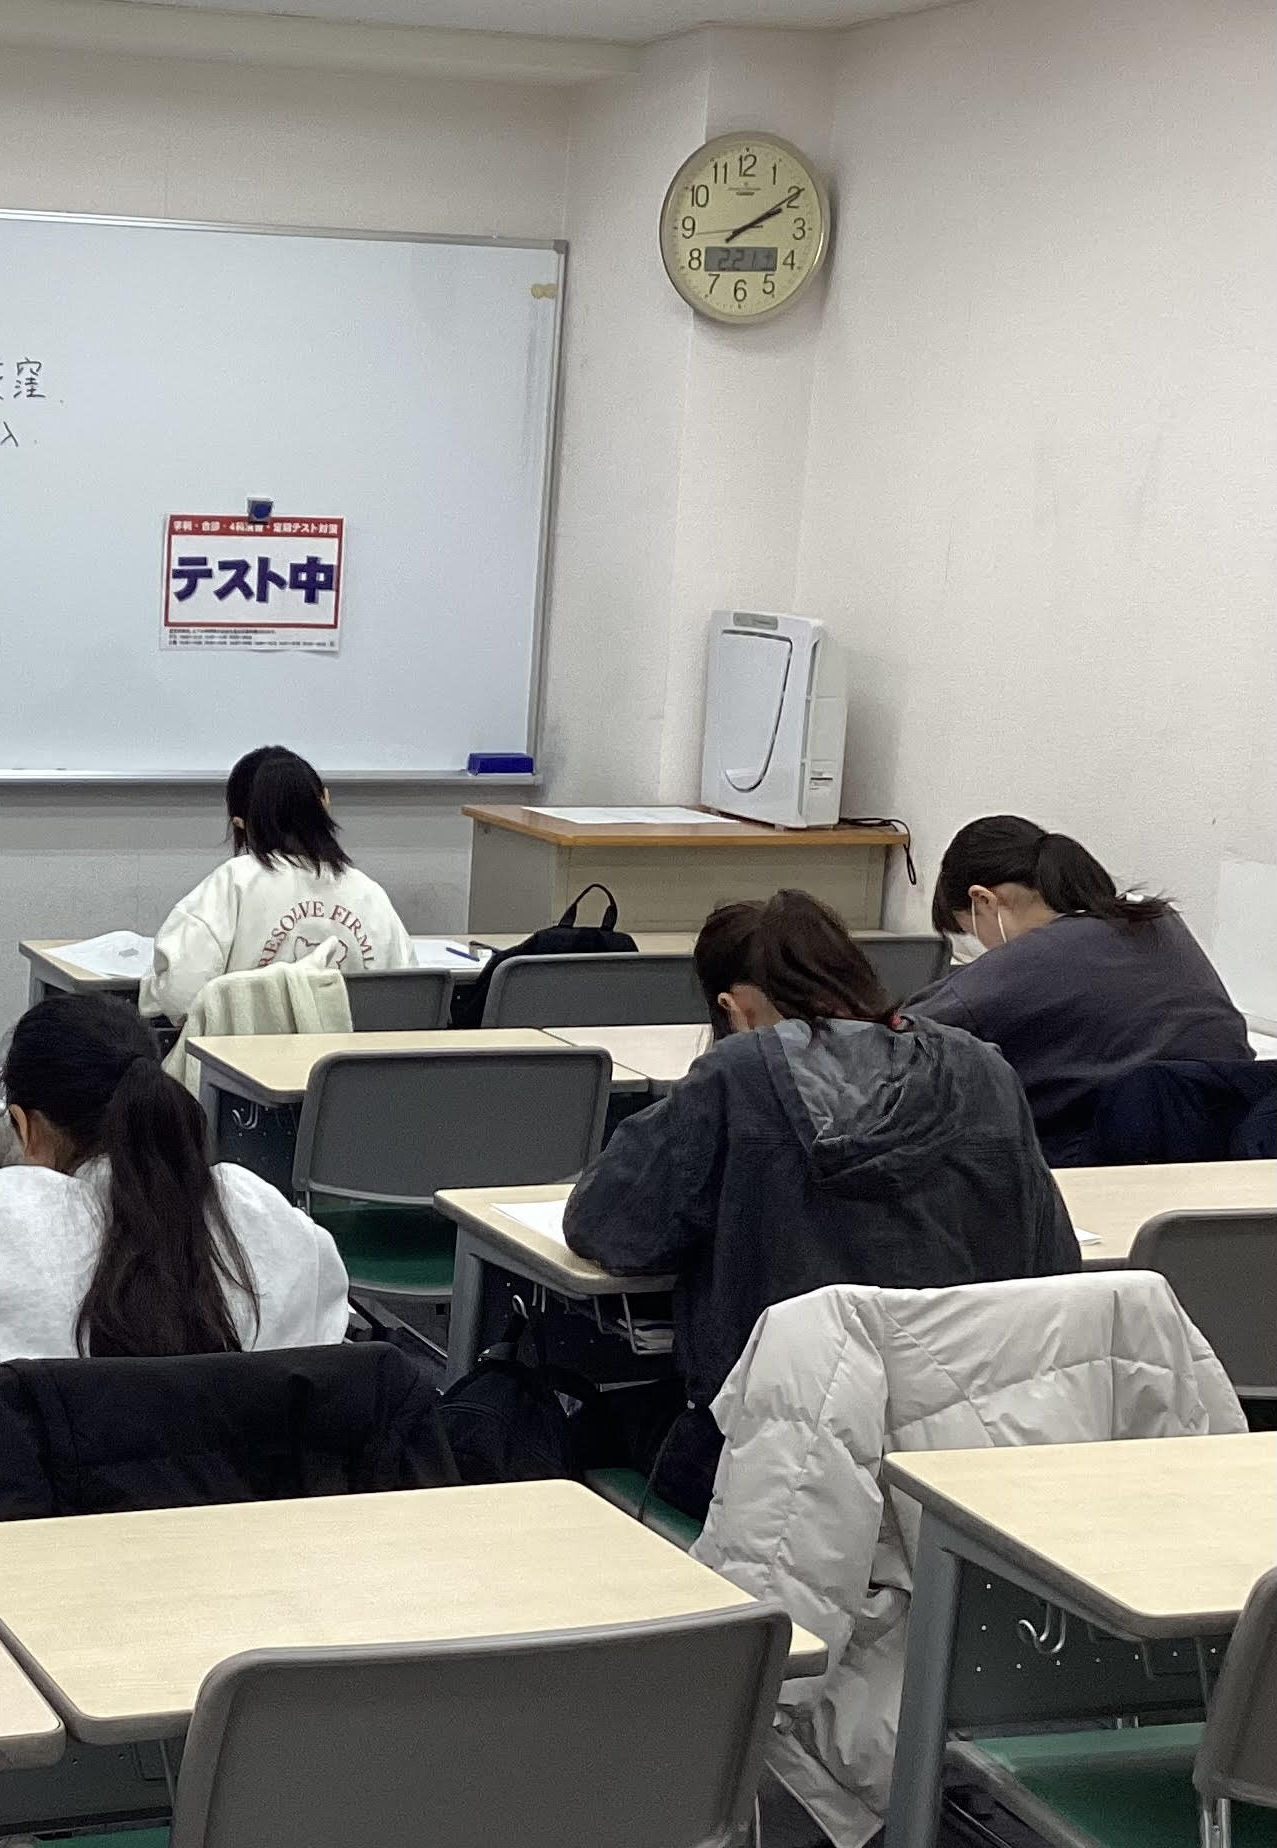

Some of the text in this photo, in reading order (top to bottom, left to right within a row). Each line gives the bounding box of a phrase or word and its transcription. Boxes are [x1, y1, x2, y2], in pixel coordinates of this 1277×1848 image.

[712, 162, 728, 184] 11
[739, 153, 757, 177] 12
[771, 163, 778, 185] 1
[691, 184, 710, 208] 10
[786, 186, 801, 209] 2
[681, 216, 696, 239] 9
[792, 217, 806, 240] 3
[688, 248, 702, 271] 8
[782, 249, 796, 270] 4
[708, 273, 721, 295] 7
[733, 279, 748, 302] 6
[762, 273, 775, 295] 5
[171, 555, 337, 604] テスト中
[258, 901, 325, 968] RESOLVE
